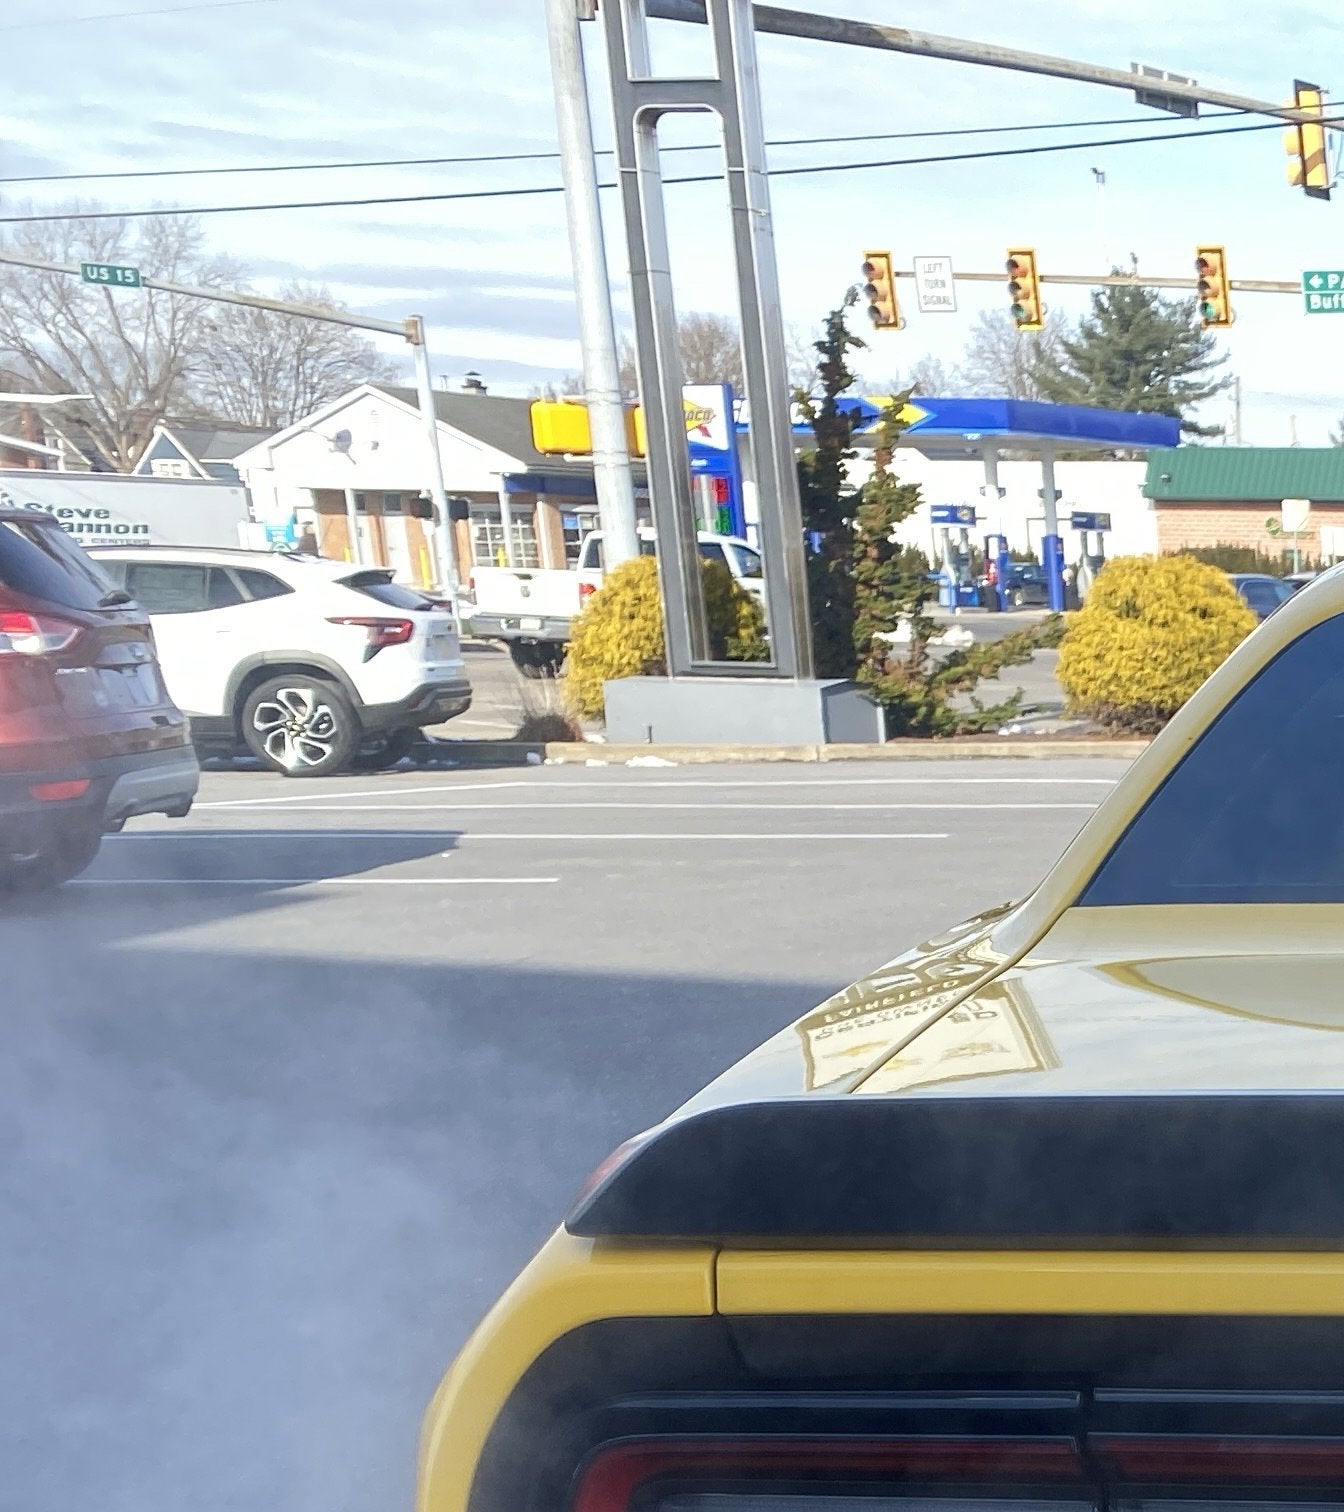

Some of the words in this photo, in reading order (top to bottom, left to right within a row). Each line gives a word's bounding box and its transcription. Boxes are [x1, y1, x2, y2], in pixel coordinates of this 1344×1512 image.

[86, 266, 110, 280] US
[116, 269, 135, 283] 15
[61, 520, 149, 534] annon
